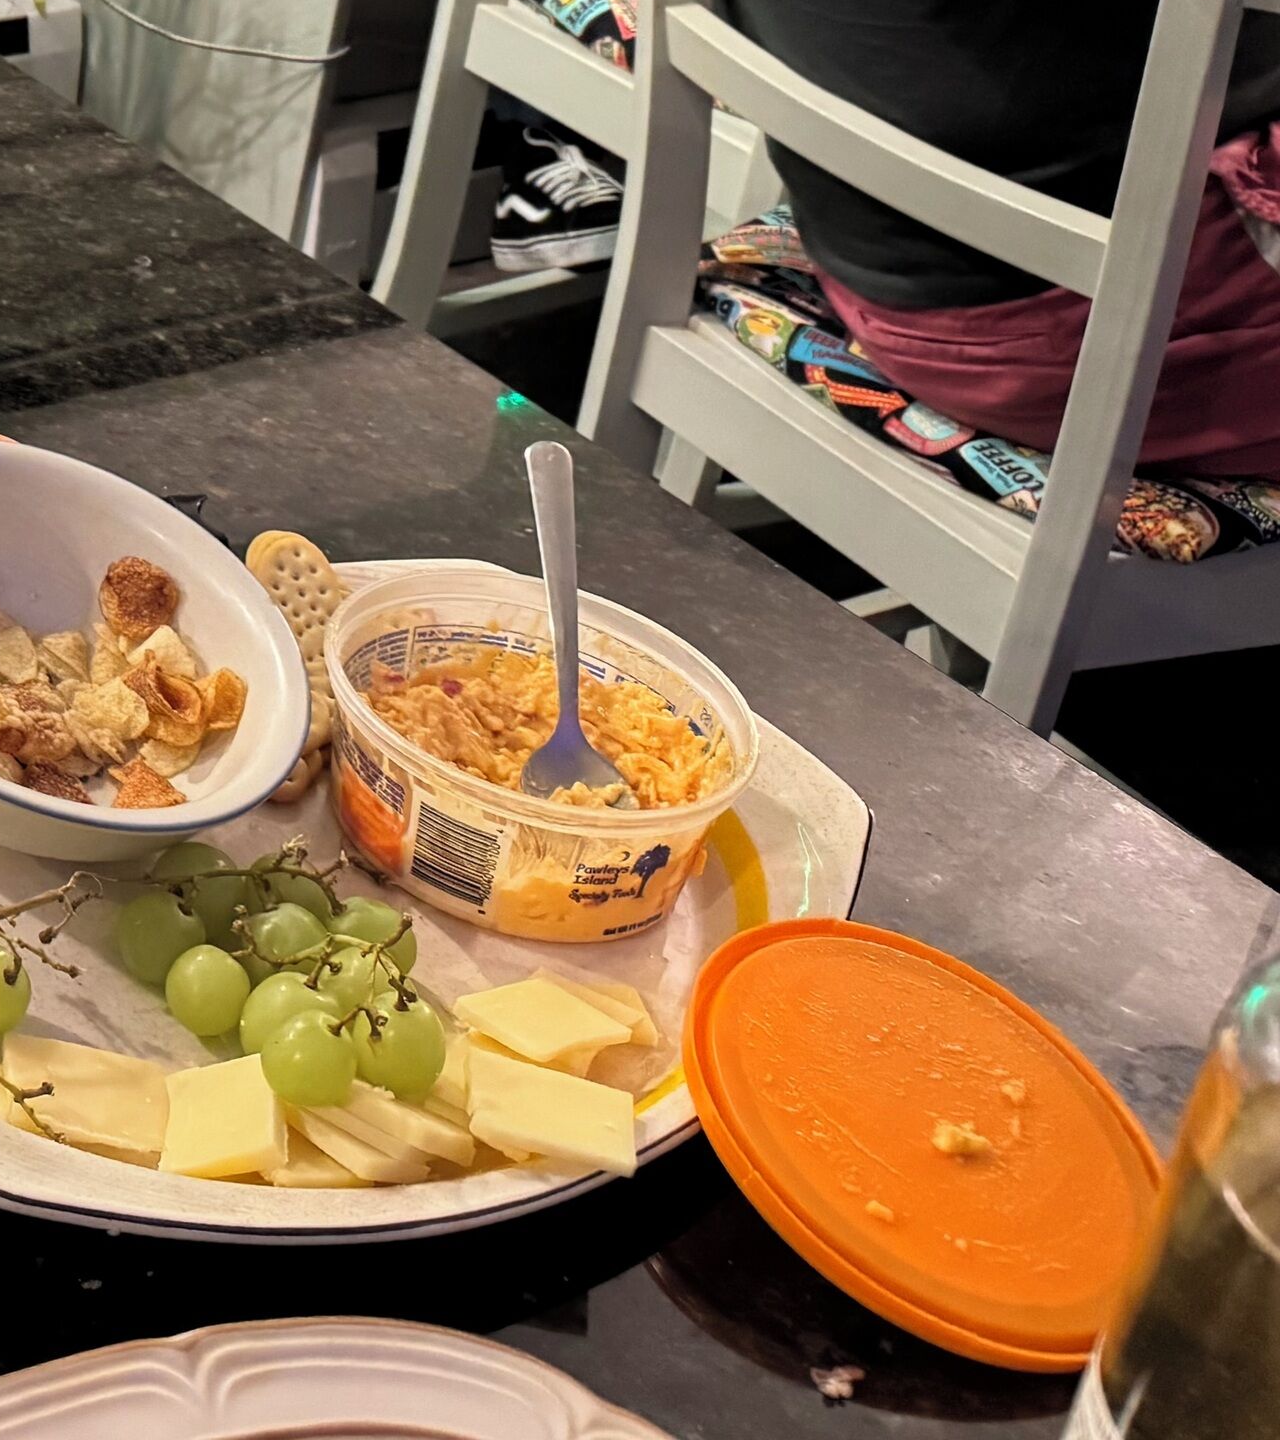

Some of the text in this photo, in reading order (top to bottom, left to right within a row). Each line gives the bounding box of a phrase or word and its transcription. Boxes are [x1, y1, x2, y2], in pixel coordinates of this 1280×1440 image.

[971, 439, 1044, 491] COFFEE
[576, 863, 630, 879] Pawleys
[572, 874, 619, 885] Island
